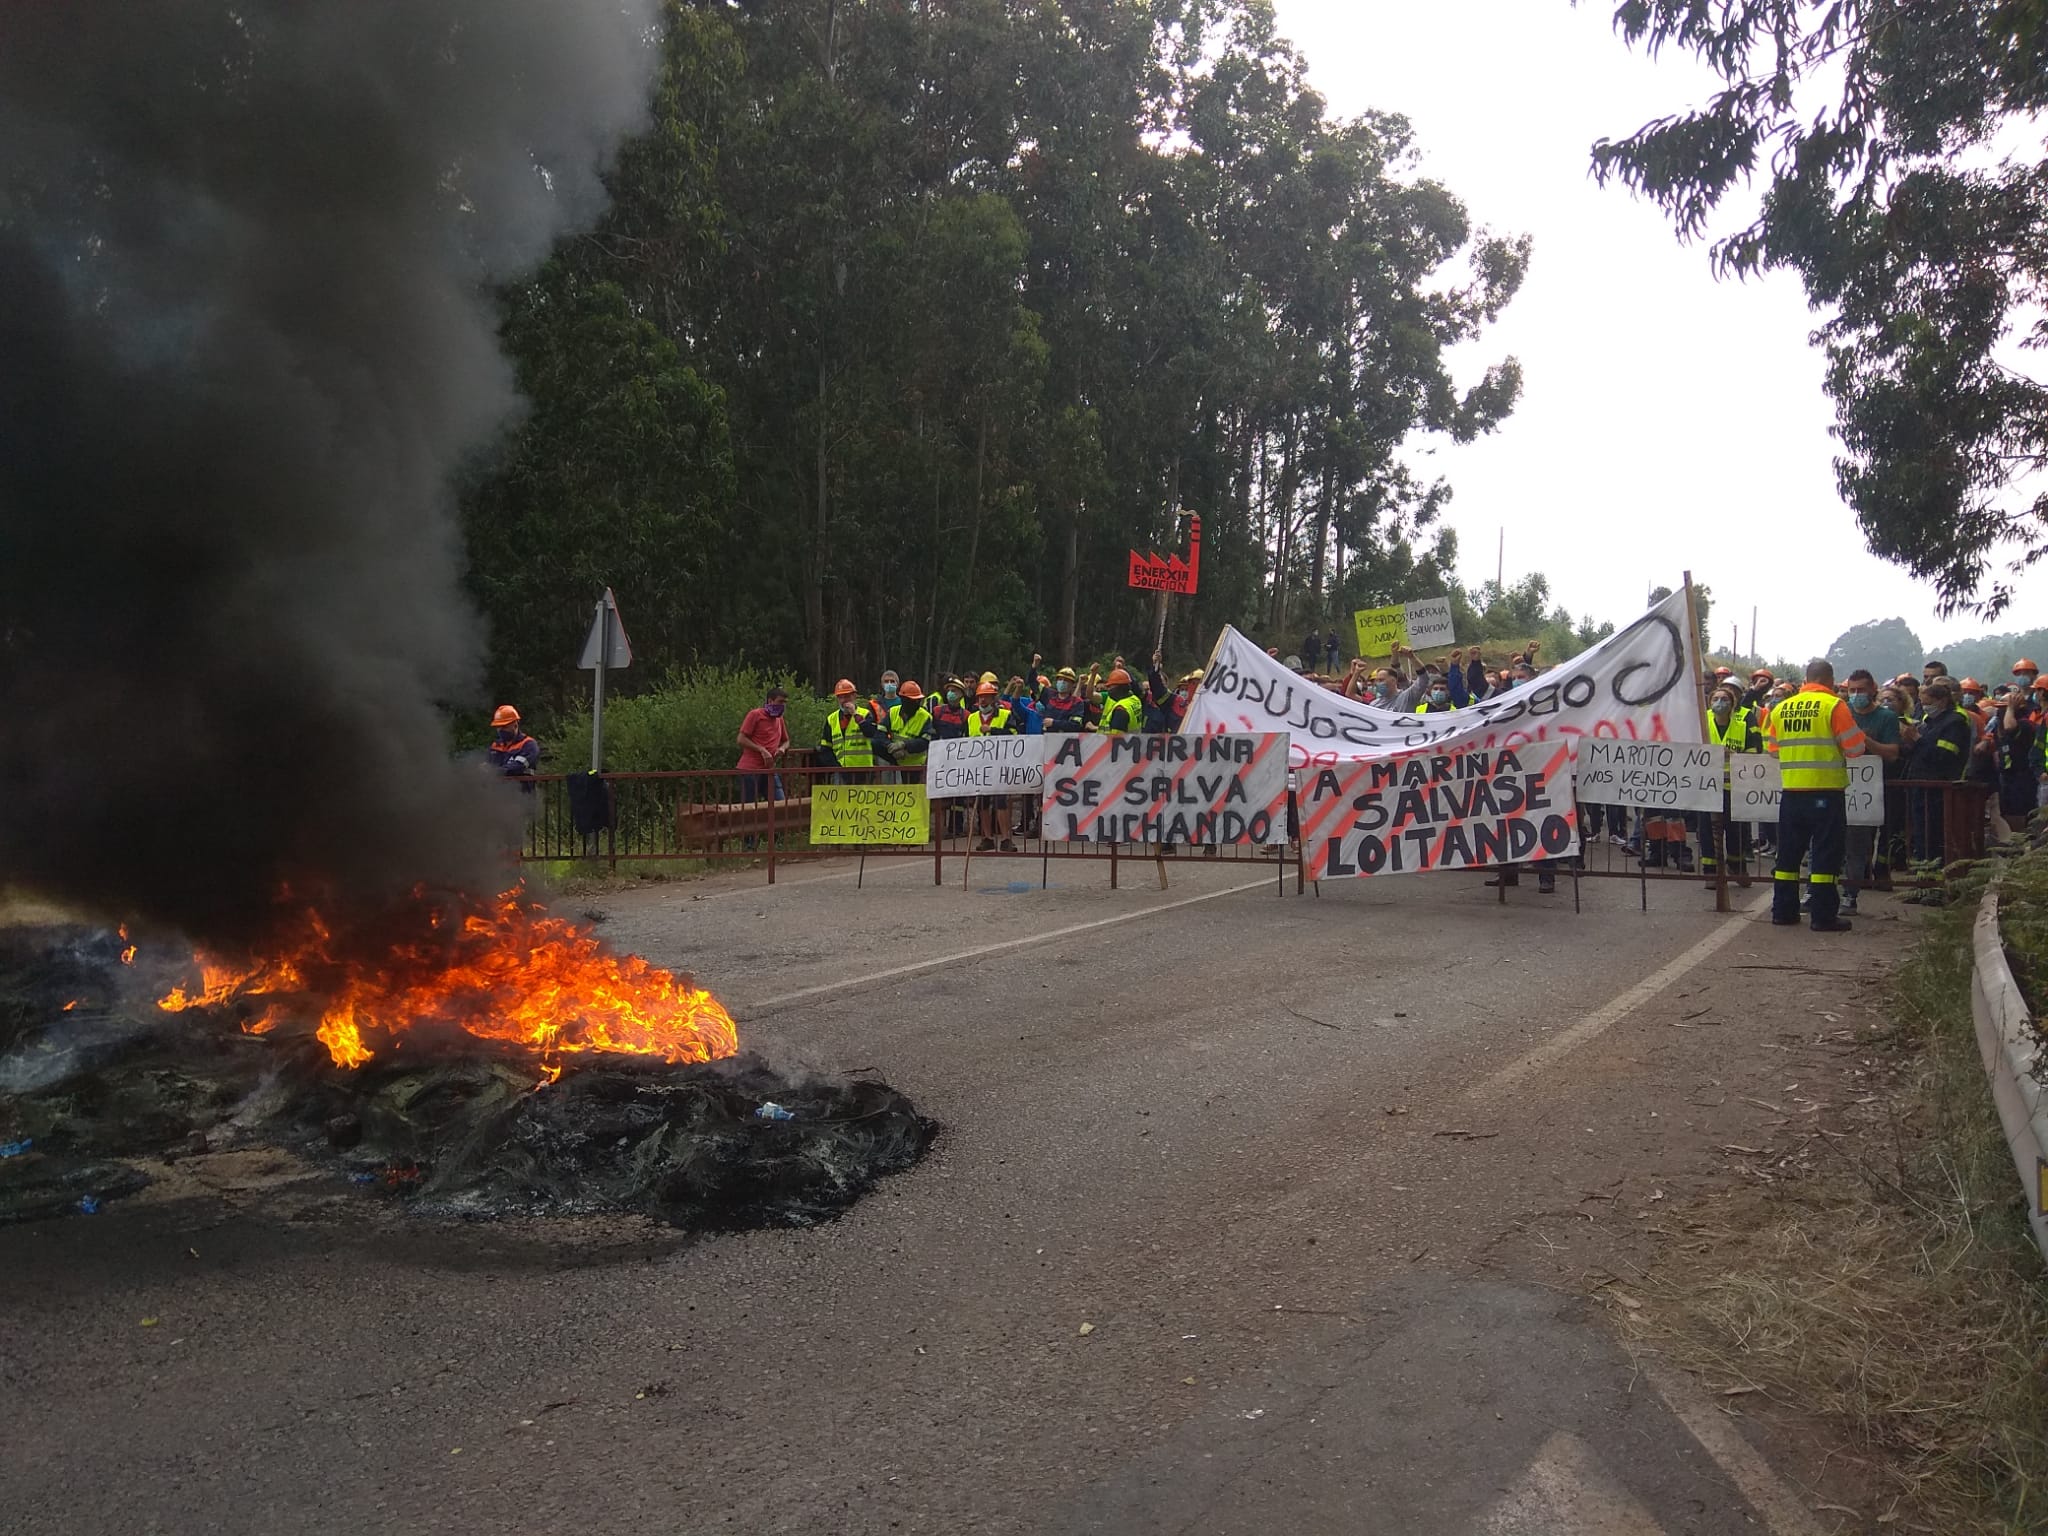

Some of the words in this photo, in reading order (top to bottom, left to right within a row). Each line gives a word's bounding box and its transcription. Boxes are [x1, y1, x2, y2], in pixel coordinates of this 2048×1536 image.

[1133, 564, 1189, 581] ENERXIA
[1409, 605, 1449, 620] ENERXIA
[1780, 709, 1819, 718] DESPIDOS
[1782, 700, 1820, 710] ALCOA
[1783, 719, 1811, 733] NON
[946, 739, 1025, 761] PEDRITO
[1055, 738, 1082, 767] A
[1111, 735, 1254, 764] MARIÑA
[1590, 743, 1673, 767] MAROTO
[1683, 748, 1711, 768] NO
[999, 765, 1043, 789] HUEVOS
[1313, 769, 1342, 802] A
[1371, 750, 1523, 789] MARIÑA
[1583, 770, 1614, 786] NOS
[1622, 769, 1692, 789] VENDAS
[1699, 775, 1718, 792] LA
[819, 789, 838, 803] NO
[848, 789, 916, 808] PODEMOS
[1055, 777, 1101, 807] SE
[1124, 774, 1247, 806] SALVA
[1618, 787, 1678, 805] MOTO
[1353, 773, 1552, 831] SÁLVASE
[831, 808, 870, 824] VIVIR
[876, 809, 910, 823] SOLO
[1067, 809, 1271, 845] LUCHANDO
[820, 825, 846, 837] DEL
[1327, 814, 1572, 877] LOITANDO
